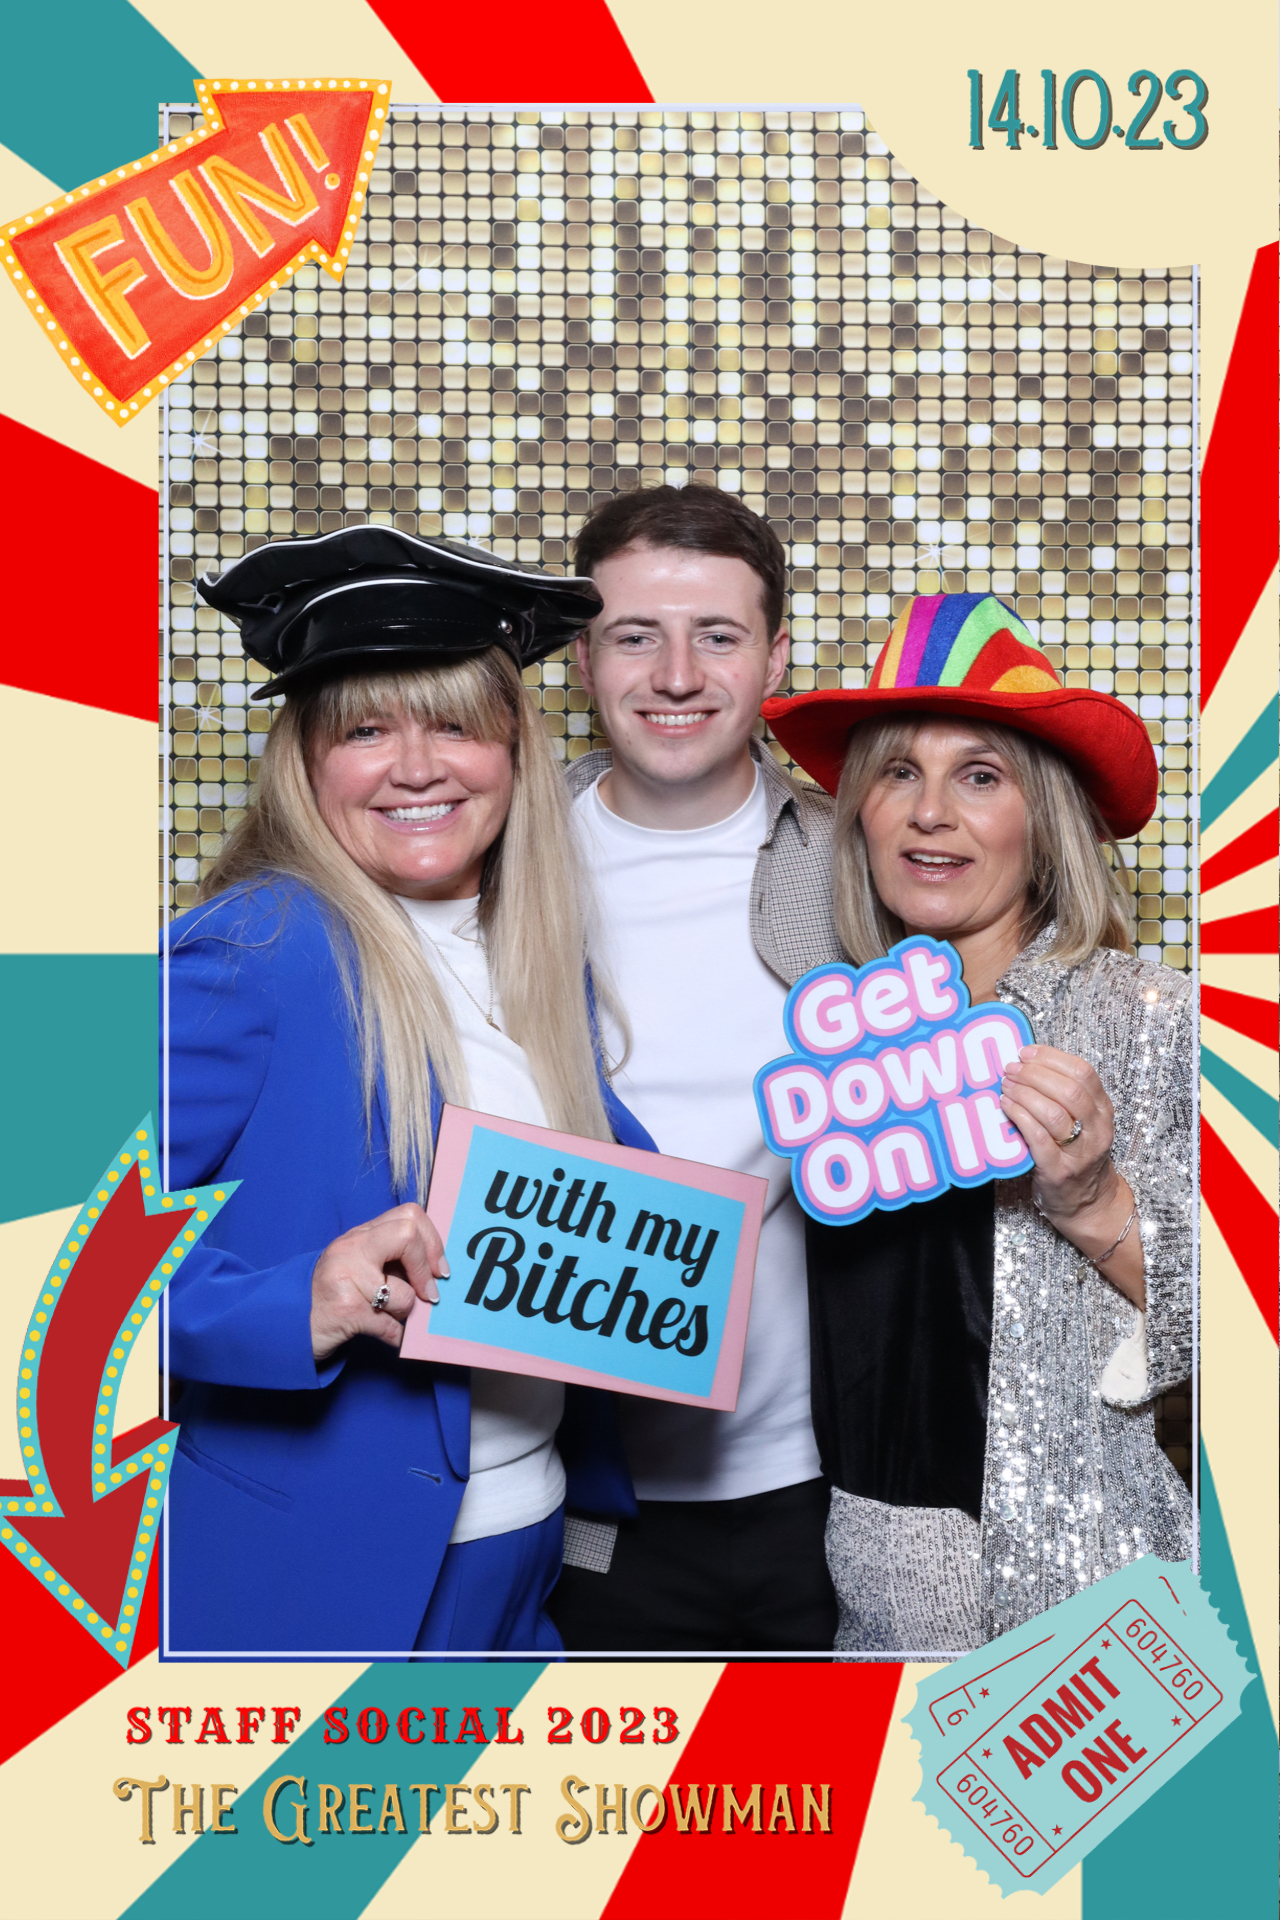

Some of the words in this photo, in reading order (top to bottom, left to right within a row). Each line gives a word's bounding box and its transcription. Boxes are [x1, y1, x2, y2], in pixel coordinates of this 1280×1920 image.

[799, 953, 952, 1049] Get
[769, 1021, 1019, 1141] Down
[806, 1132, 931, 1208] On
[944, 1096, 1022, 1170] It
[484, 1167, 616, 1243] with
[625, 1209, 720, 1288] my
[464, 1226, 709, 1357] Bitches
